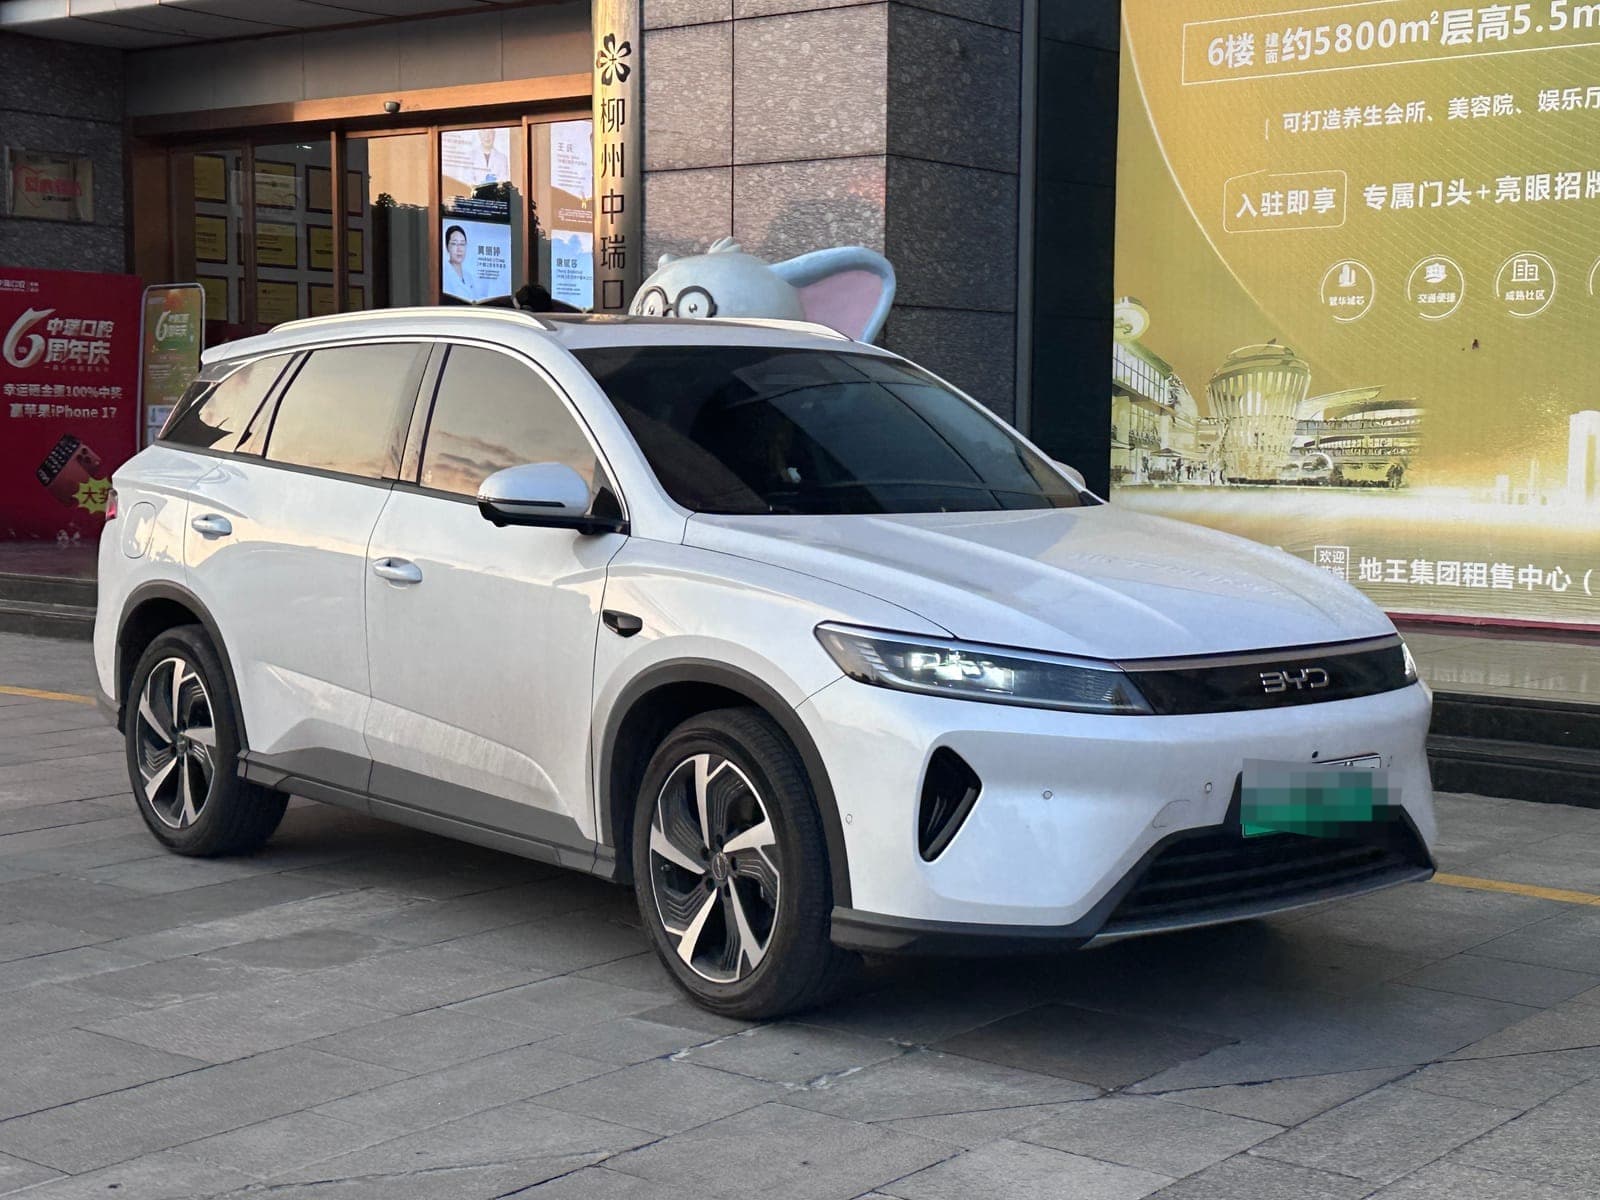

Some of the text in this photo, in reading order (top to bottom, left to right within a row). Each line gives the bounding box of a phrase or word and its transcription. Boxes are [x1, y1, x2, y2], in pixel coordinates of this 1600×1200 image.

[1208, 32, 1255, 68] 6楼
[600, 97, 627, 309] 柳州中瑞口
[1236, 187, 1337, 218] 入驻即享
[1417, 292, 1456, 304] 交通便捷
[1504, 289, 1545, 301] 成熟社区
[3, 307, 56, 368] 6
[46, 317, 115, 338] 中瑞口腔
[44, 338, 111, 365] 周年庆
[101, 406, 118, 419] 17
[1319, 549, 1345, 564] 欢迎
[1259, 667, 1330, 694] BYD
